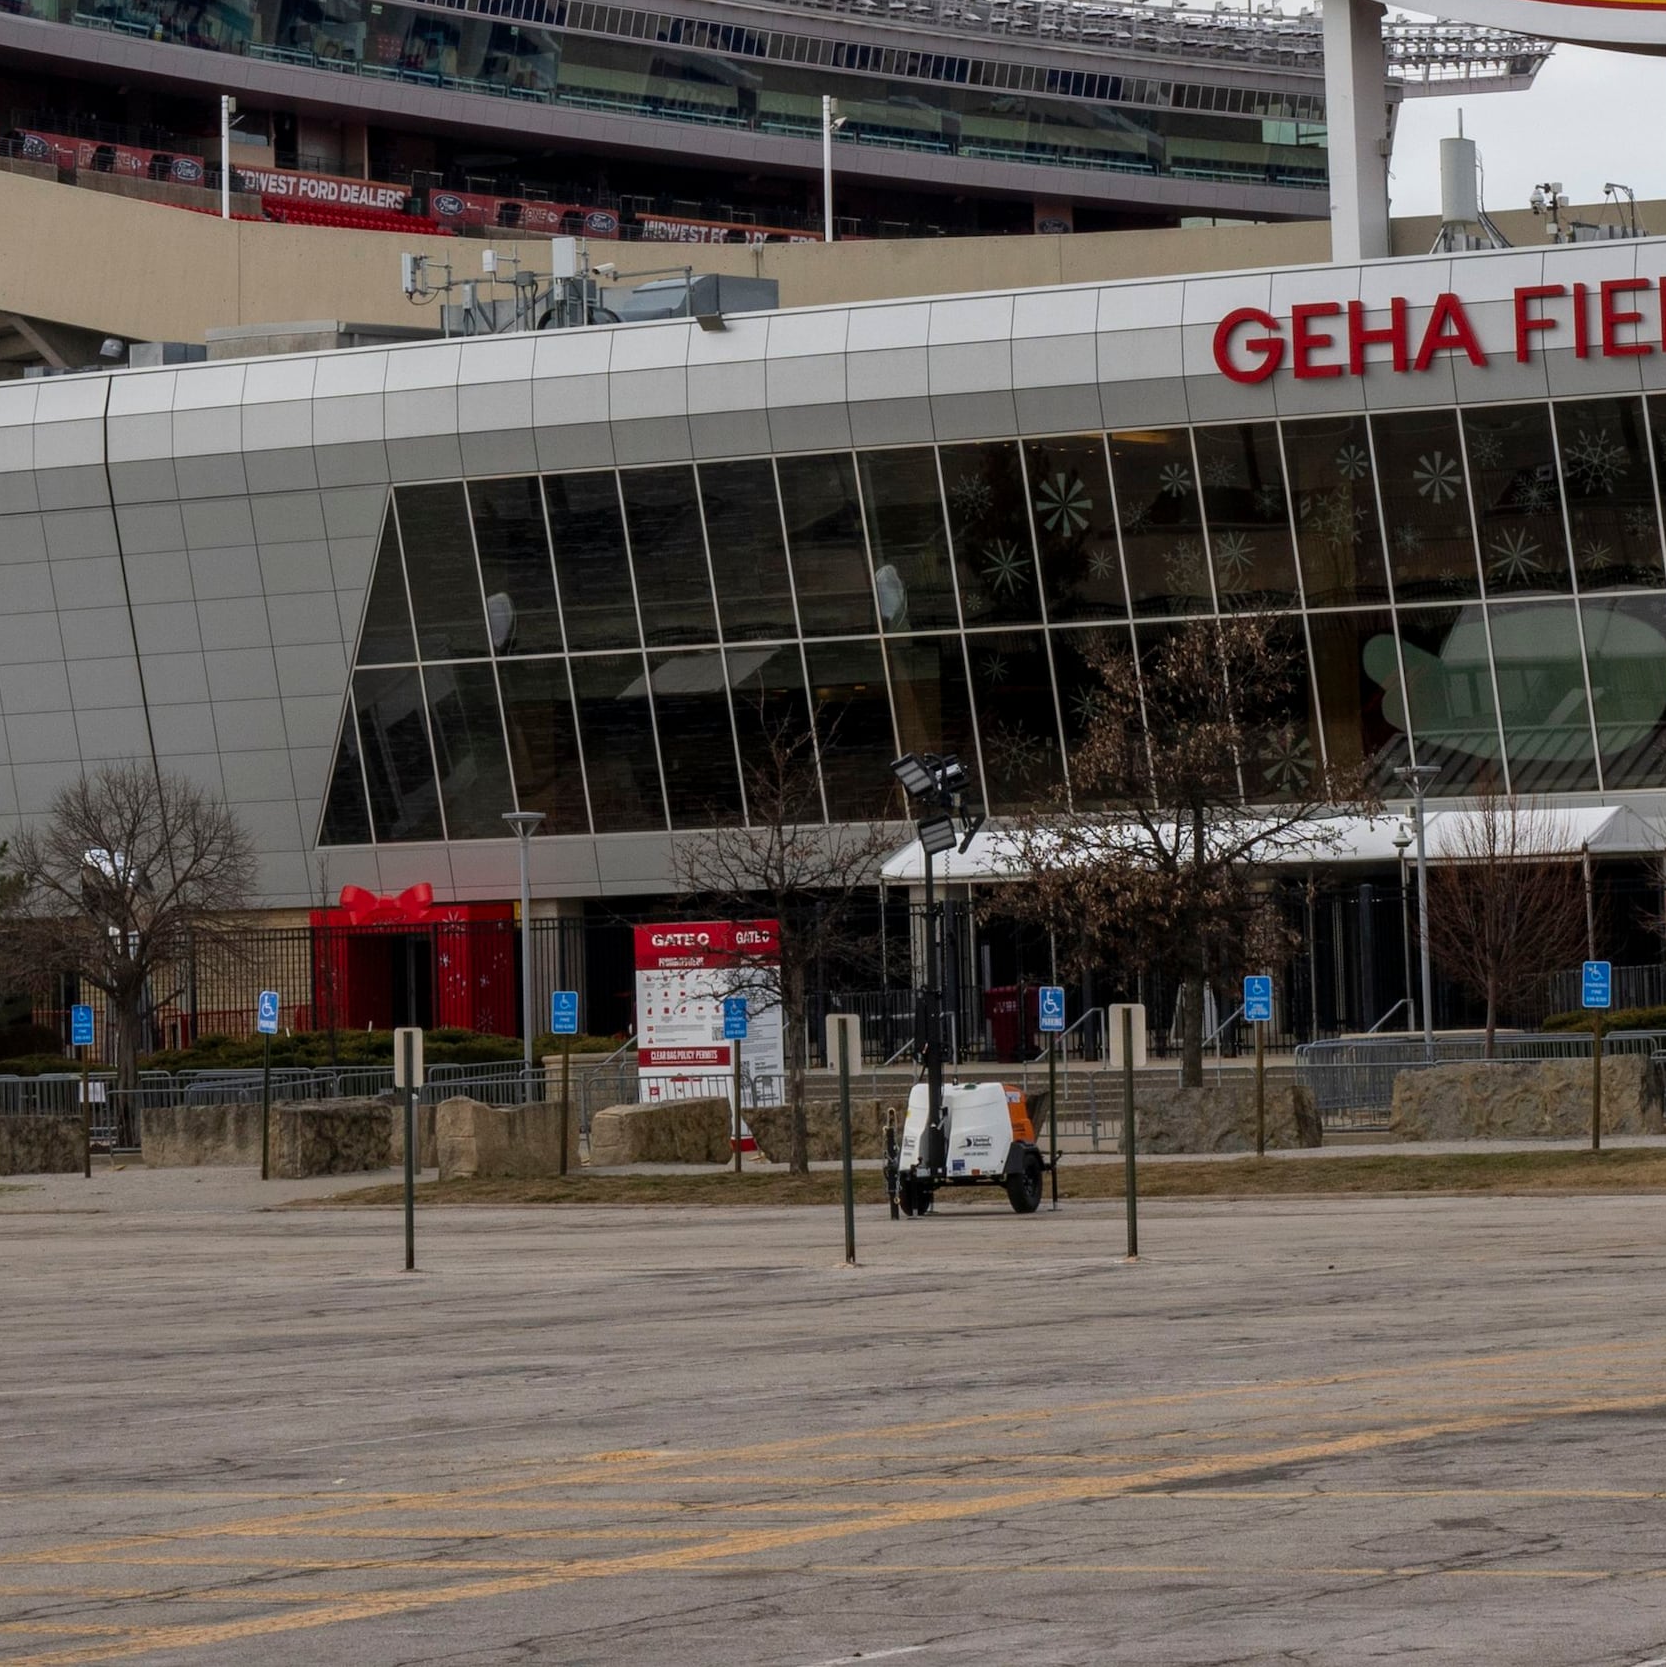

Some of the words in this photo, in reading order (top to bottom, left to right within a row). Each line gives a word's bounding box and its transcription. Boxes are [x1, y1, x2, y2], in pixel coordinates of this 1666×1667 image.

[298, 178, 339, 201] FORD
[340, 185, 406, 210] DEALERS
[1213, 293, 1487, 384] GEHA
[652, 933, 695, 946] GATE
[697, 933, 710, 946] C
[736, 931, 761, 944] GATE
